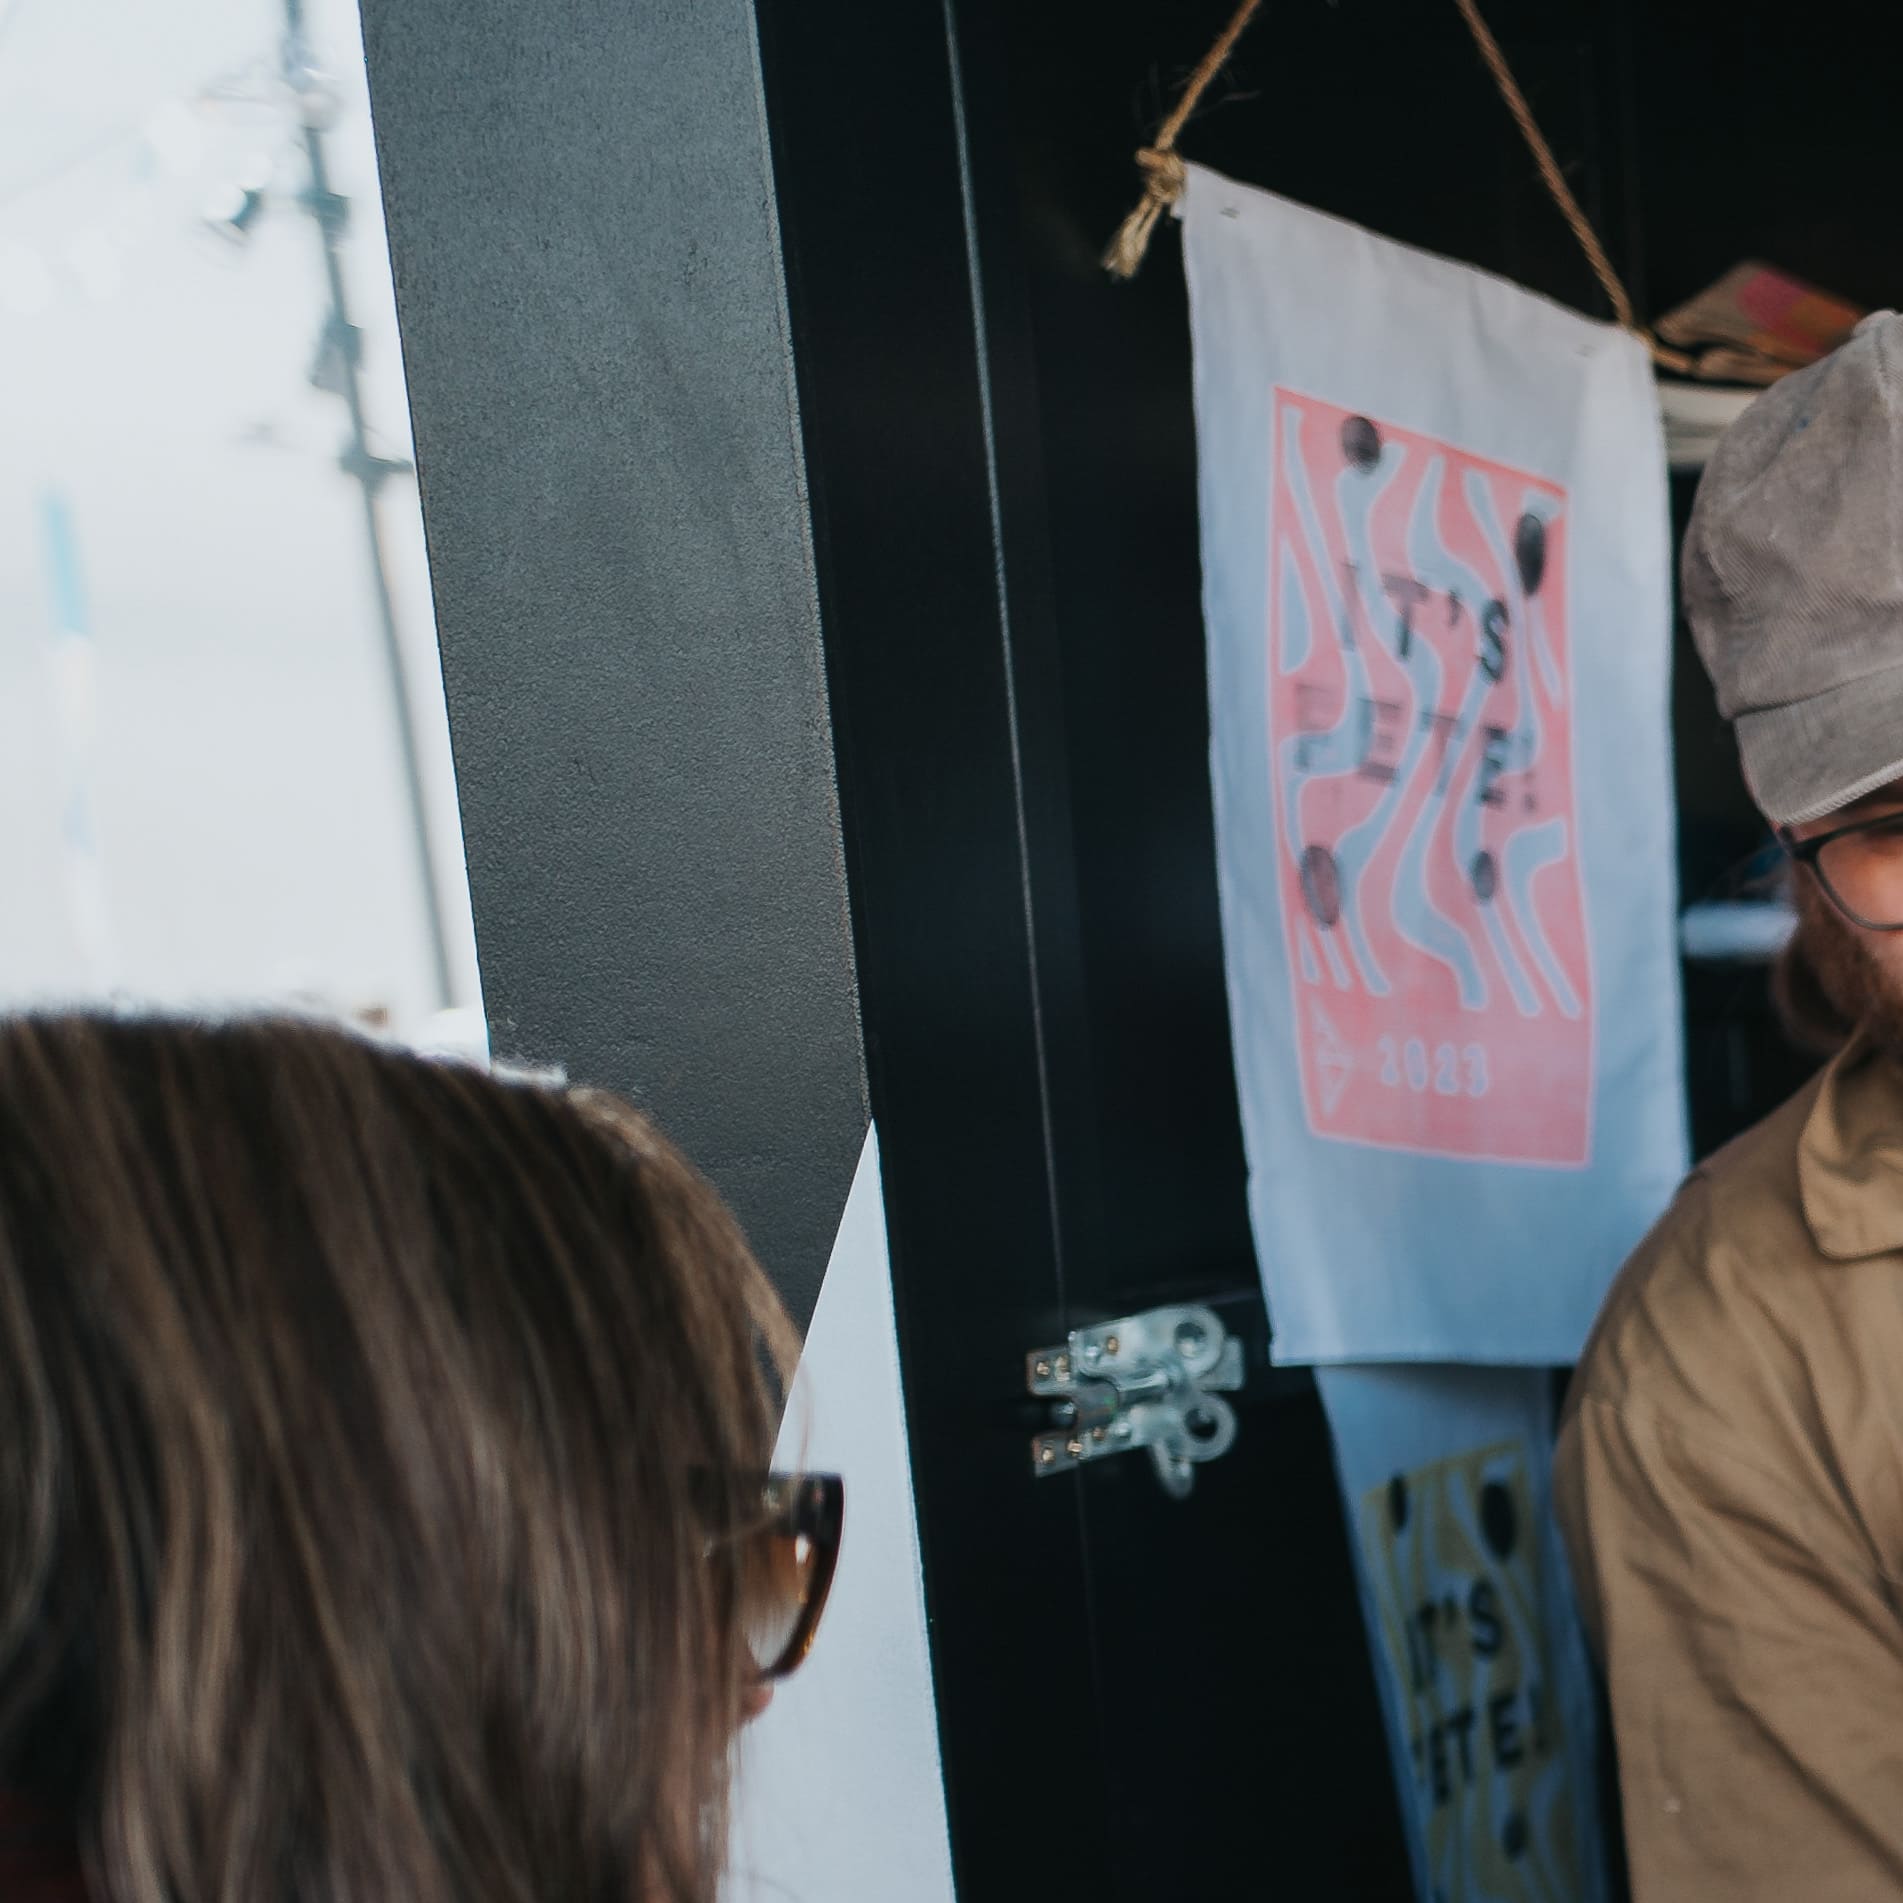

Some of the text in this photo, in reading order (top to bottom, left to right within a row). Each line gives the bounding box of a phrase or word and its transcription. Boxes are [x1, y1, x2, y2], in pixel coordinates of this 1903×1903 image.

[1341, 560, 1511, 685] IT'S
[1377, 1032, 1491, 1099] 2023
[1405, 1572, 1504, 1694] IT'S
